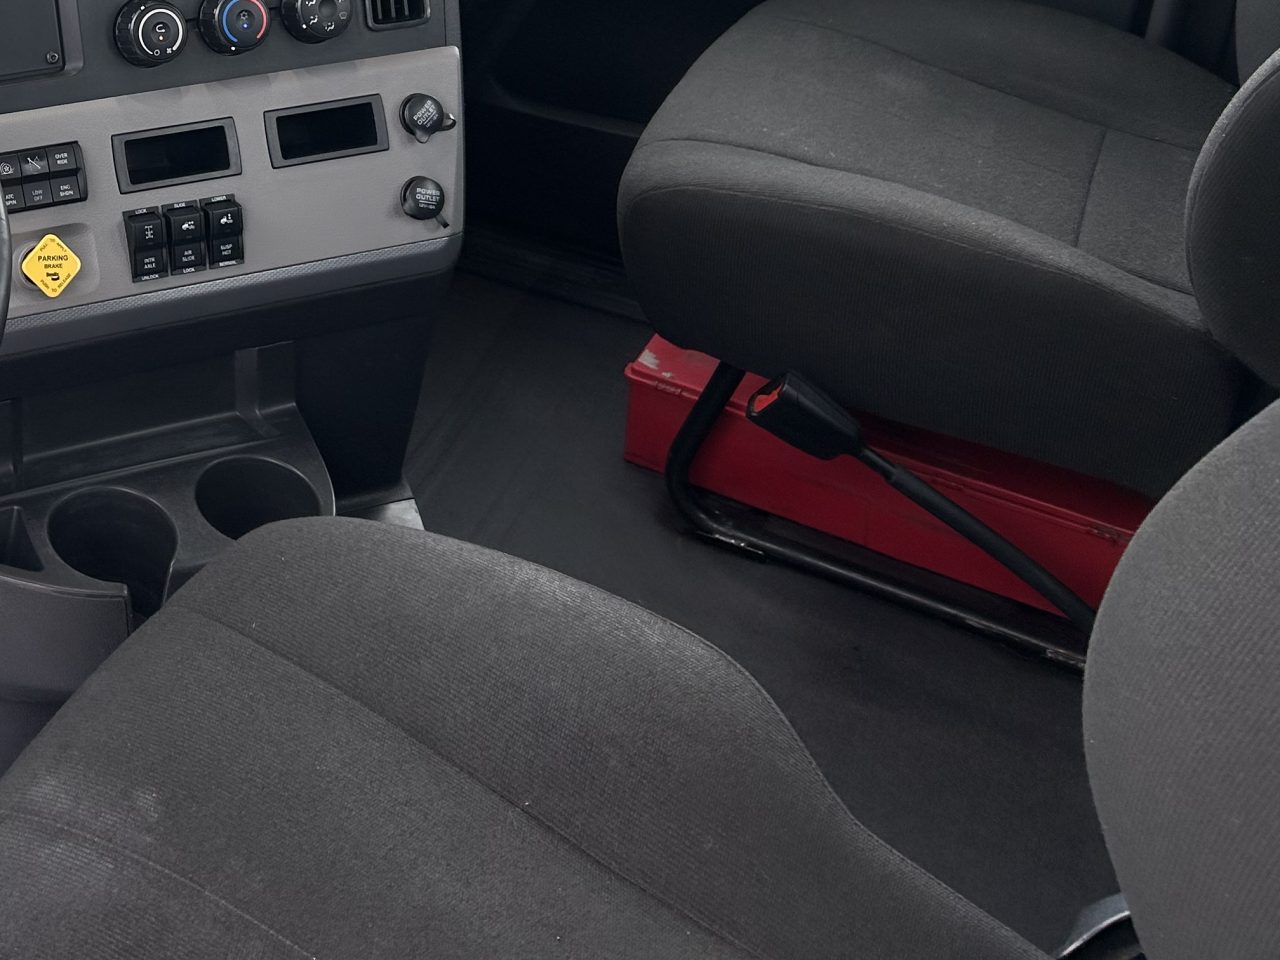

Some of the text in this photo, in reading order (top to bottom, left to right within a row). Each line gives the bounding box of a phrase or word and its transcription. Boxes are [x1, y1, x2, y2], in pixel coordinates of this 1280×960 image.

[413, 100, 432, 120] POWER
[417, 104, 436, 125] OUTLET
[416, 194, 440, 202] OUTLET
[417, 188, 440, 196] POWER
